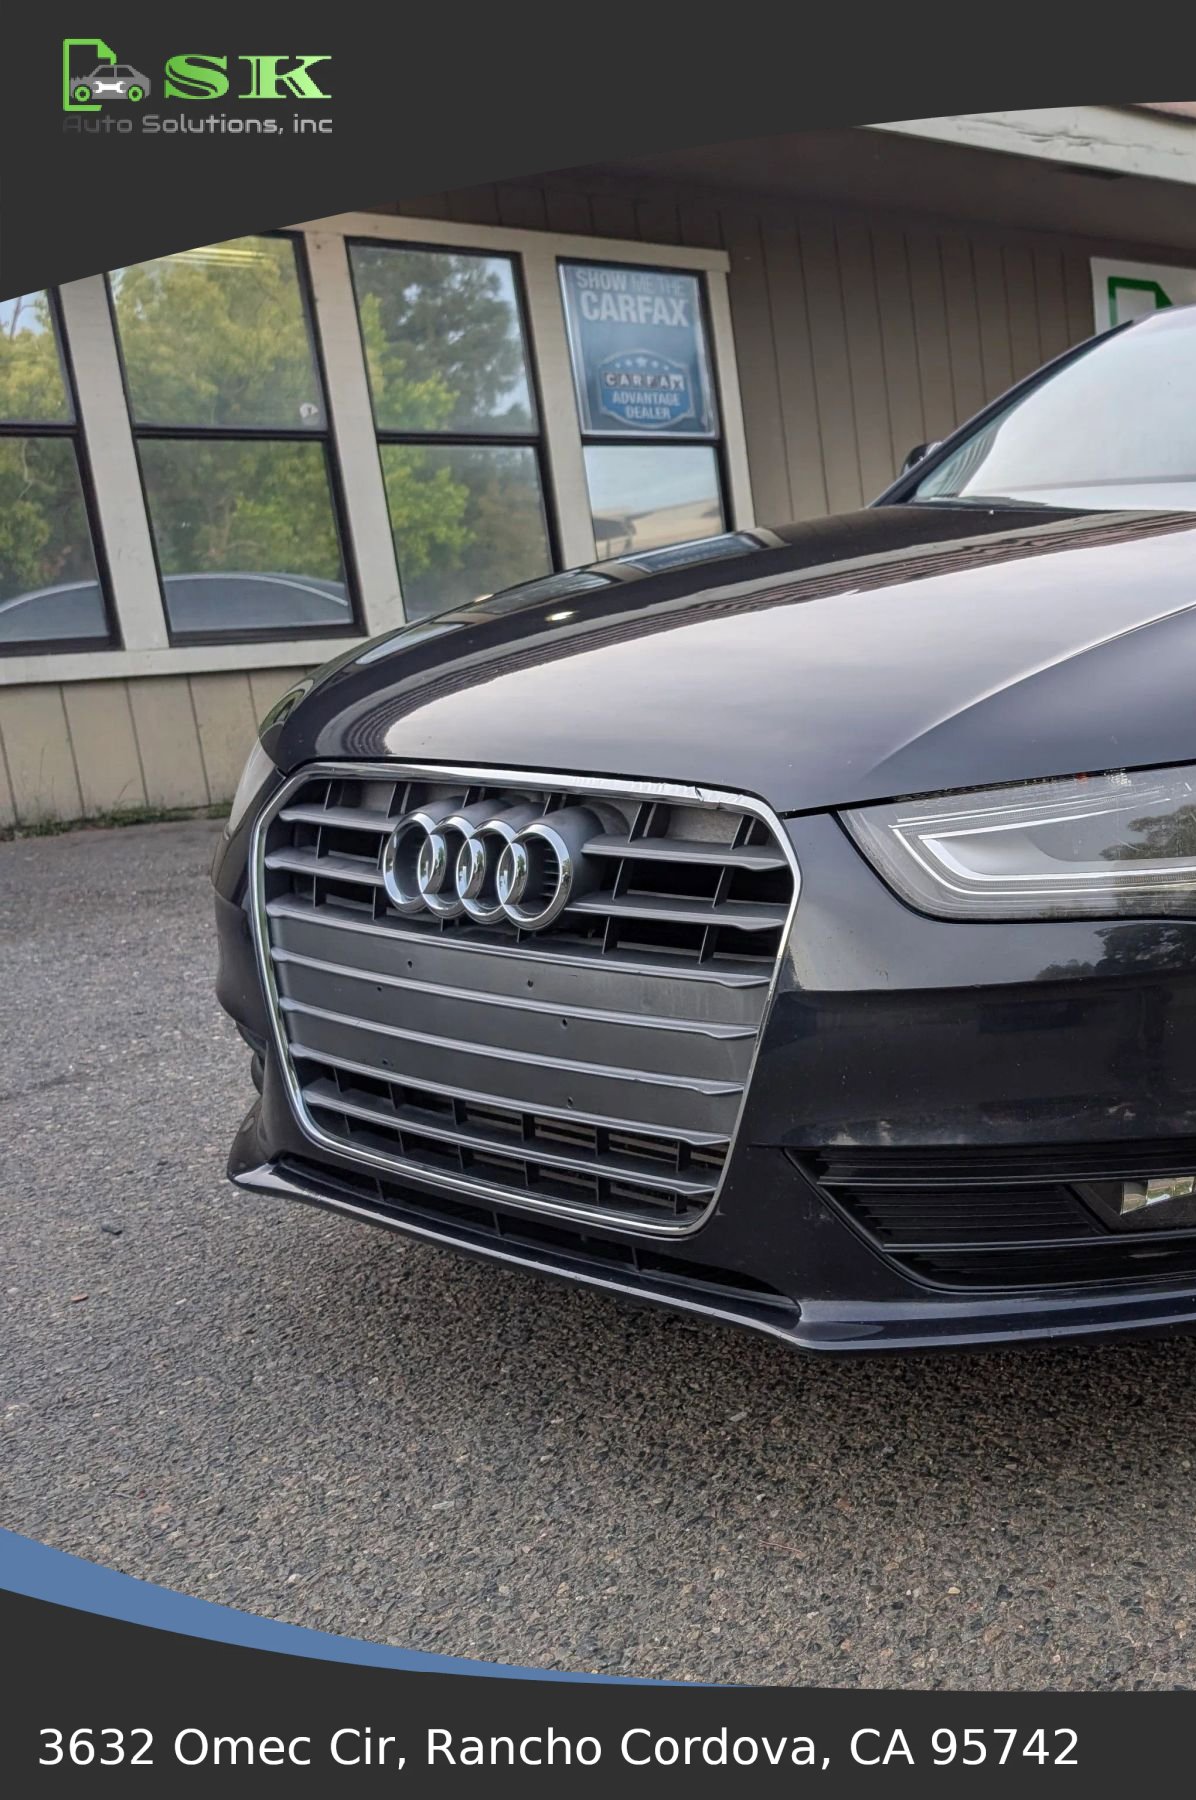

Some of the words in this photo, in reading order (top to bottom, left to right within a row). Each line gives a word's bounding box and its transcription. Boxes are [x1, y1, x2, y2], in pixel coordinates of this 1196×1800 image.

[576, 269, 627, 292] SHOW
[631, 274, 657, 295] ME
[660, 277, 687, 297] THE
[580, 290, 689, 328] CARFAX
[612, 391, 680, 407] ADVANTAGE
[625, 406, 672, 420] DEALER
